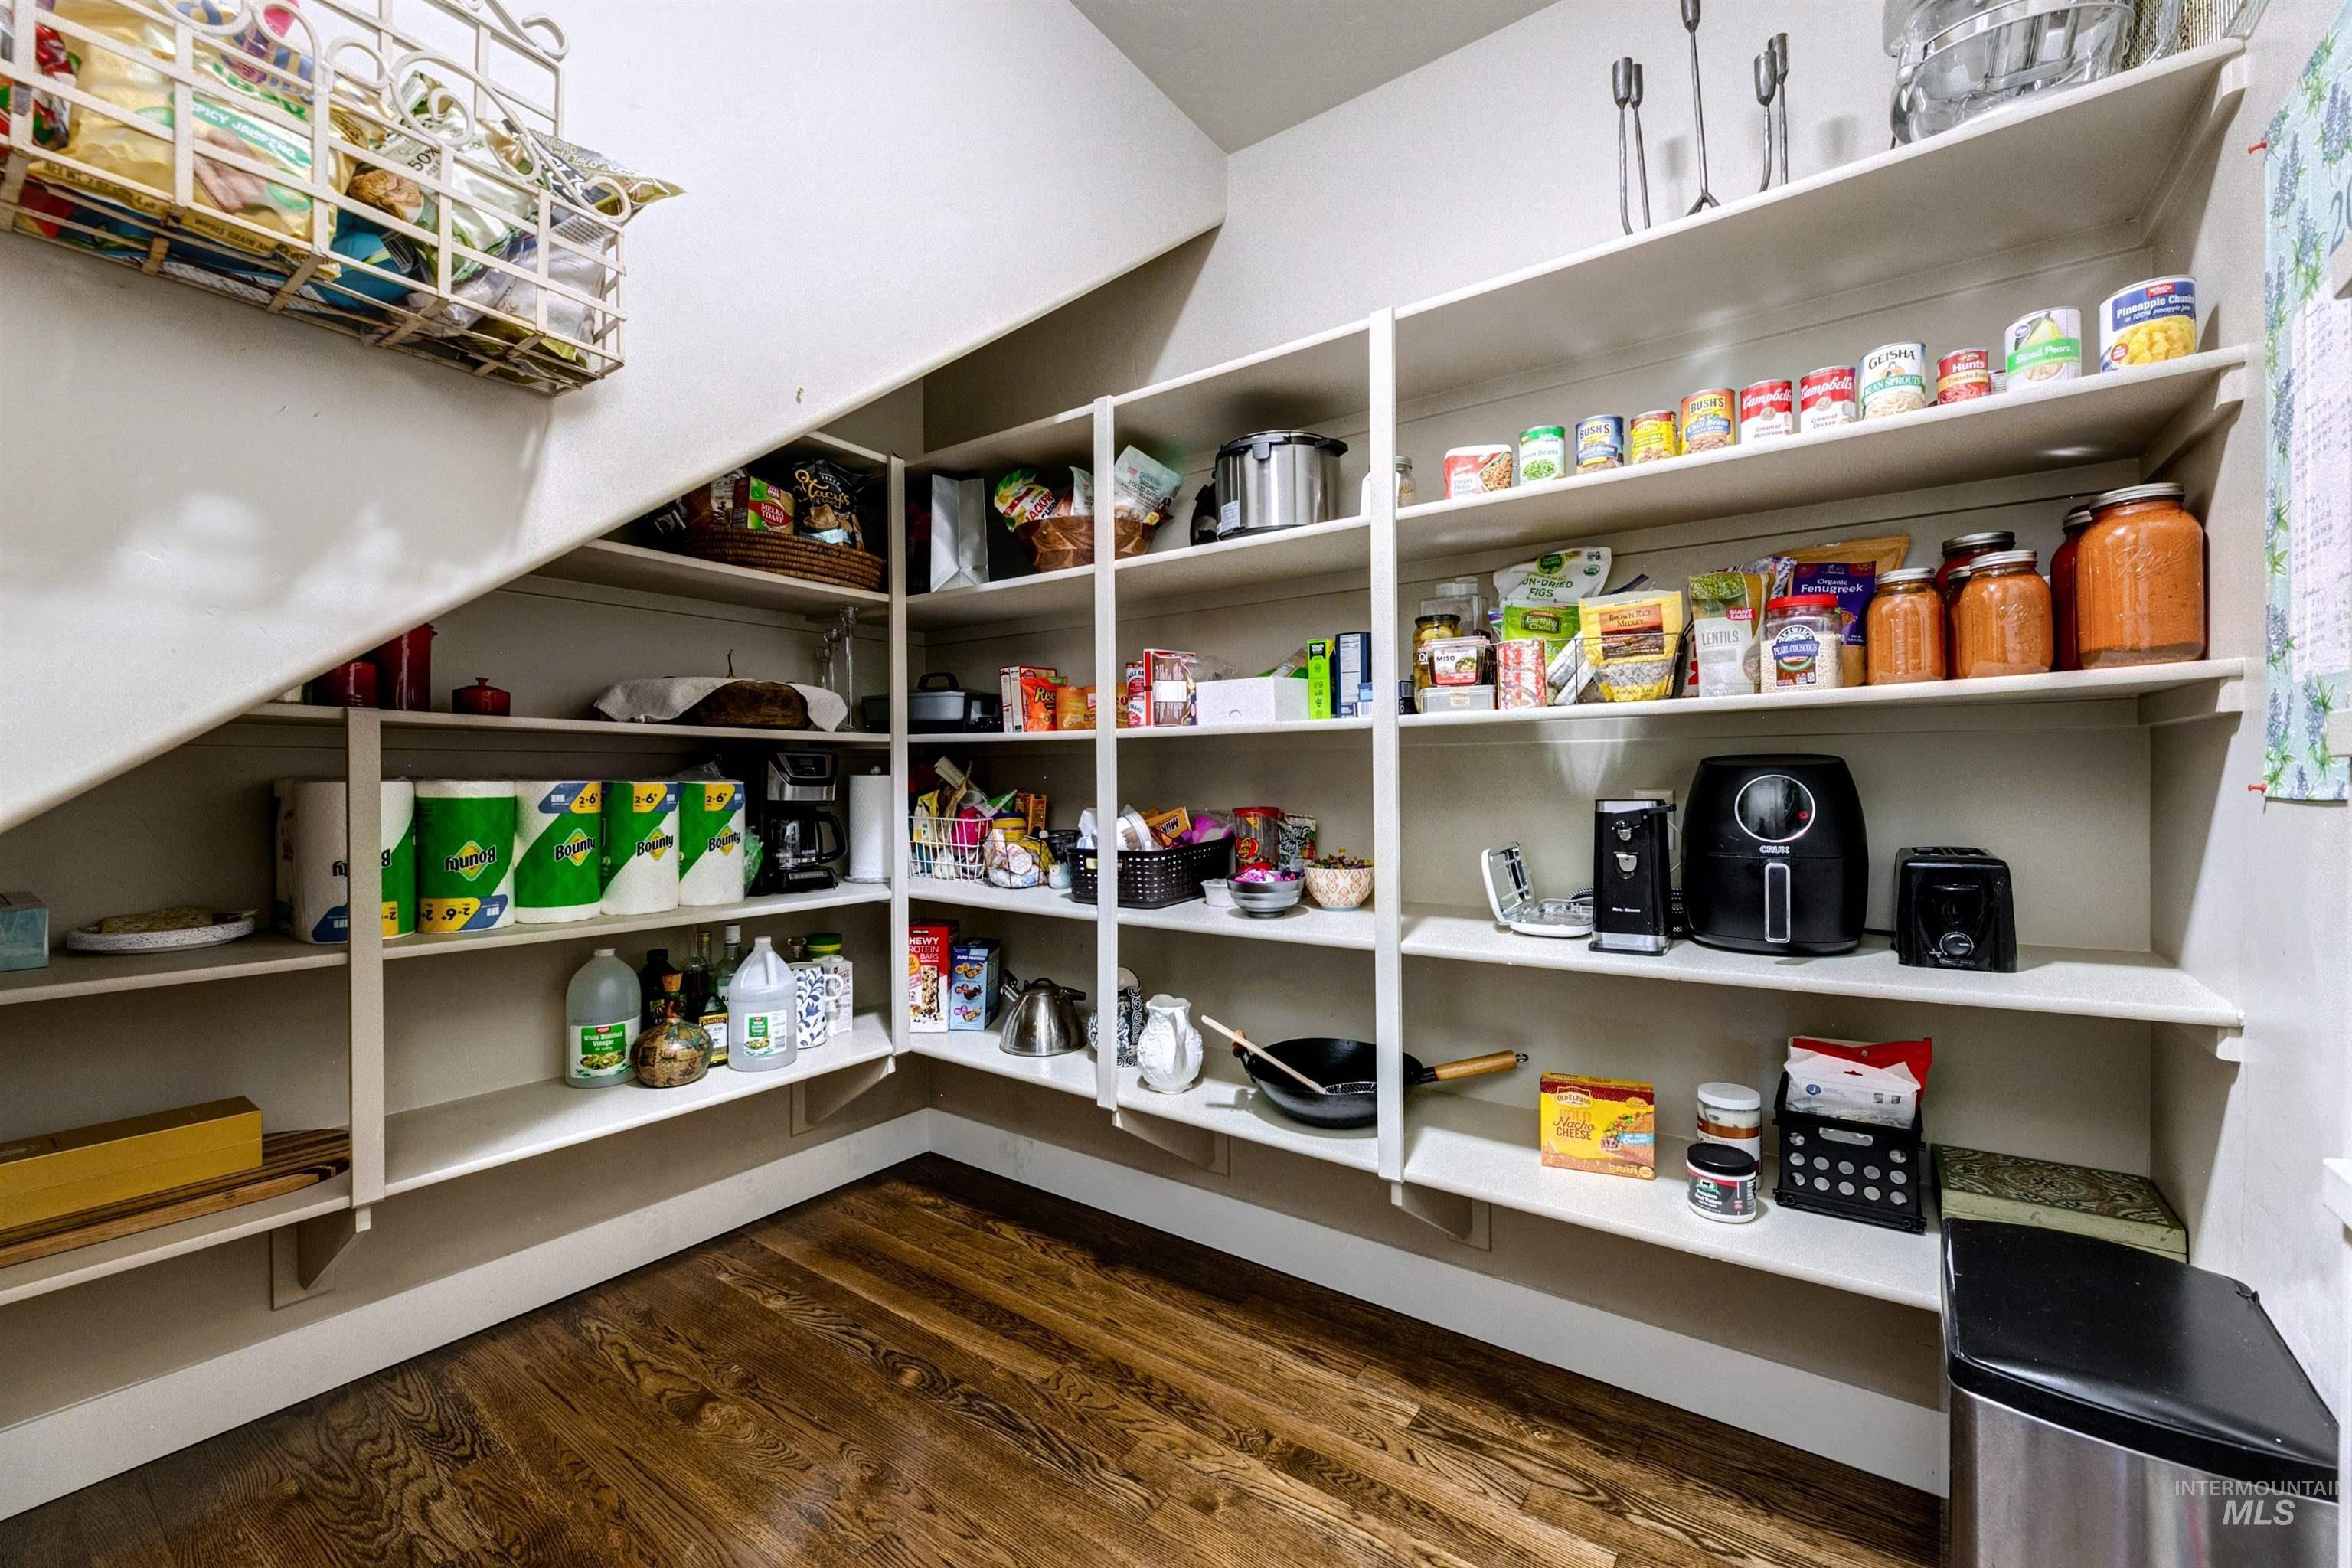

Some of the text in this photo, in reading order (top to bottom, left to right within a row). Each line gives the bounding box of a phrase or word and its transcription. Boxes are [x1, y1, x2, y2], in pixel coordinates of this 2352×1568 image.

[2116, 297, 2166, 319] Pineapple
[1868, 348, 1916, 370] GEISHA
[1886, 376, 1922, 387] SPROUTS
[1947, 373, 1974, 384] Tomato
[1800, 376, 1852, 400] Campbell's
[1690, 397, 1724, 413] BUSH'S
[1811, 414, 1831, 423] Cream
[1812, 420, 1837, 430] Chicken
[1580, 423, 1610, 439] BUSH'S
[760, 502, 785, 518] MELBA
[760, 509, 785, 524] TOAST
[1522, 577, 1573, 589] UN-DRIED
[1801, 583, 1864, 594] Fenugreek
[1817, 578, 1848, 586] Organic
[1529, 587, 1554, 598] FIGS
[1526, 616, 1558, 627] Earthly
[1609, 612, 1635, 622] BROWN
[1701, 630, 1740, 645] LENTILS
[555, 837, 596, 861] Bounty
[637, 835, 674, 857] Bounty
[708, 832, 741, 852] Bounty
[1759, 845, 1790, 854] CRUX
[445, 845, 496, 871] Bounty
[600, 1031, 623, 1040] Distilled
[1576, 1096, 1591, 1105] PASO
[1553, 1116, 1597, 1131] Nacho
[1556, 1126, 1592, 1141] CHEESE
